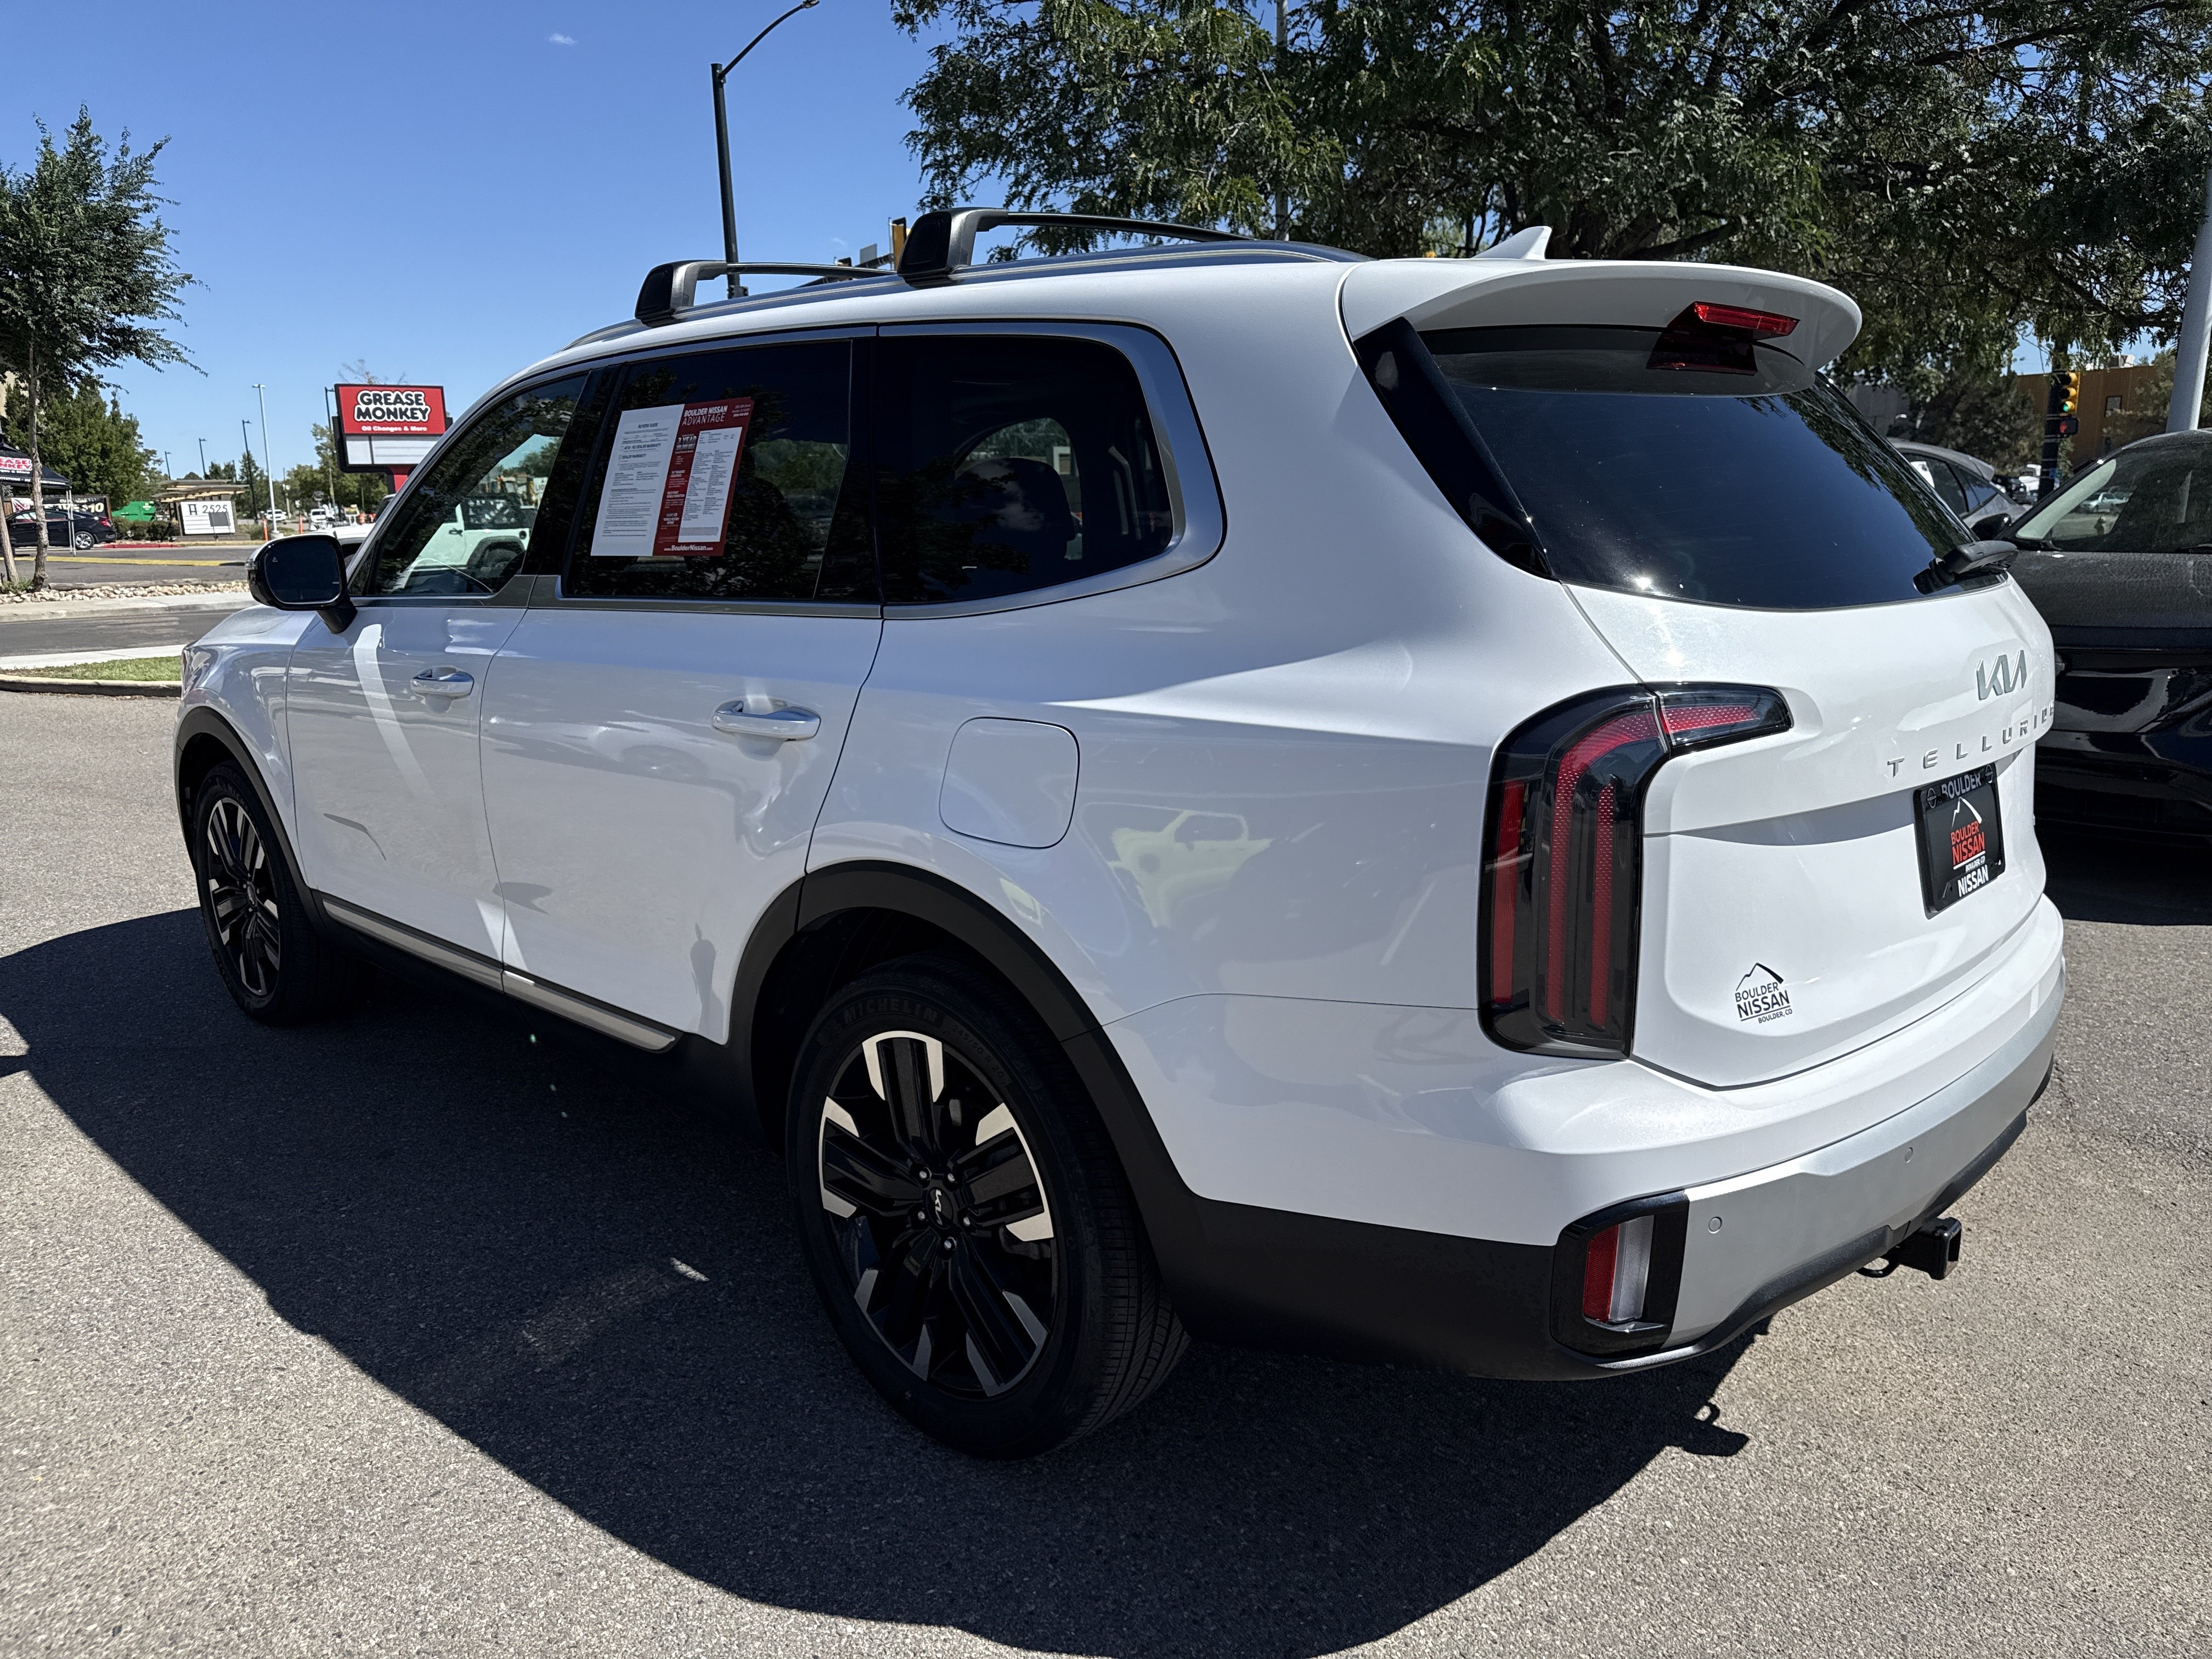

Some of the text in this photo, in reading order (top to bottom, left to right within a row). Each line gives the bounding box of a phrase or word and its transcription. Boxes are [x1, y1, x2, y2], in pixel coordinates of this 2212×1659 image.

[359, 392, 424, 406] GREASE
[684, 408, 708, 417] BOULDER
[708, 405, 729, 414] NISSAN
[357, 407, 429, 420] MONKEY
[682, 413, 726, 426] ADVANTAGE
[1976, 650, 2027, 701] KIA
[1942, 774, 1982, 799] BOULDER
[1950, 820, 1979, 845] BOULDER
[1951, 832, 1985, 866] NISSAN
[1957, 865, 1989, 898] NISSAN
[1735, 981, 1779, 1003] BOULDER
[1737, 990, 1790, 1019] NISSAN
[843, 997, 939, 1024] MICHELIN
[1758, 1011, 1785, 1024] BOULDER,
